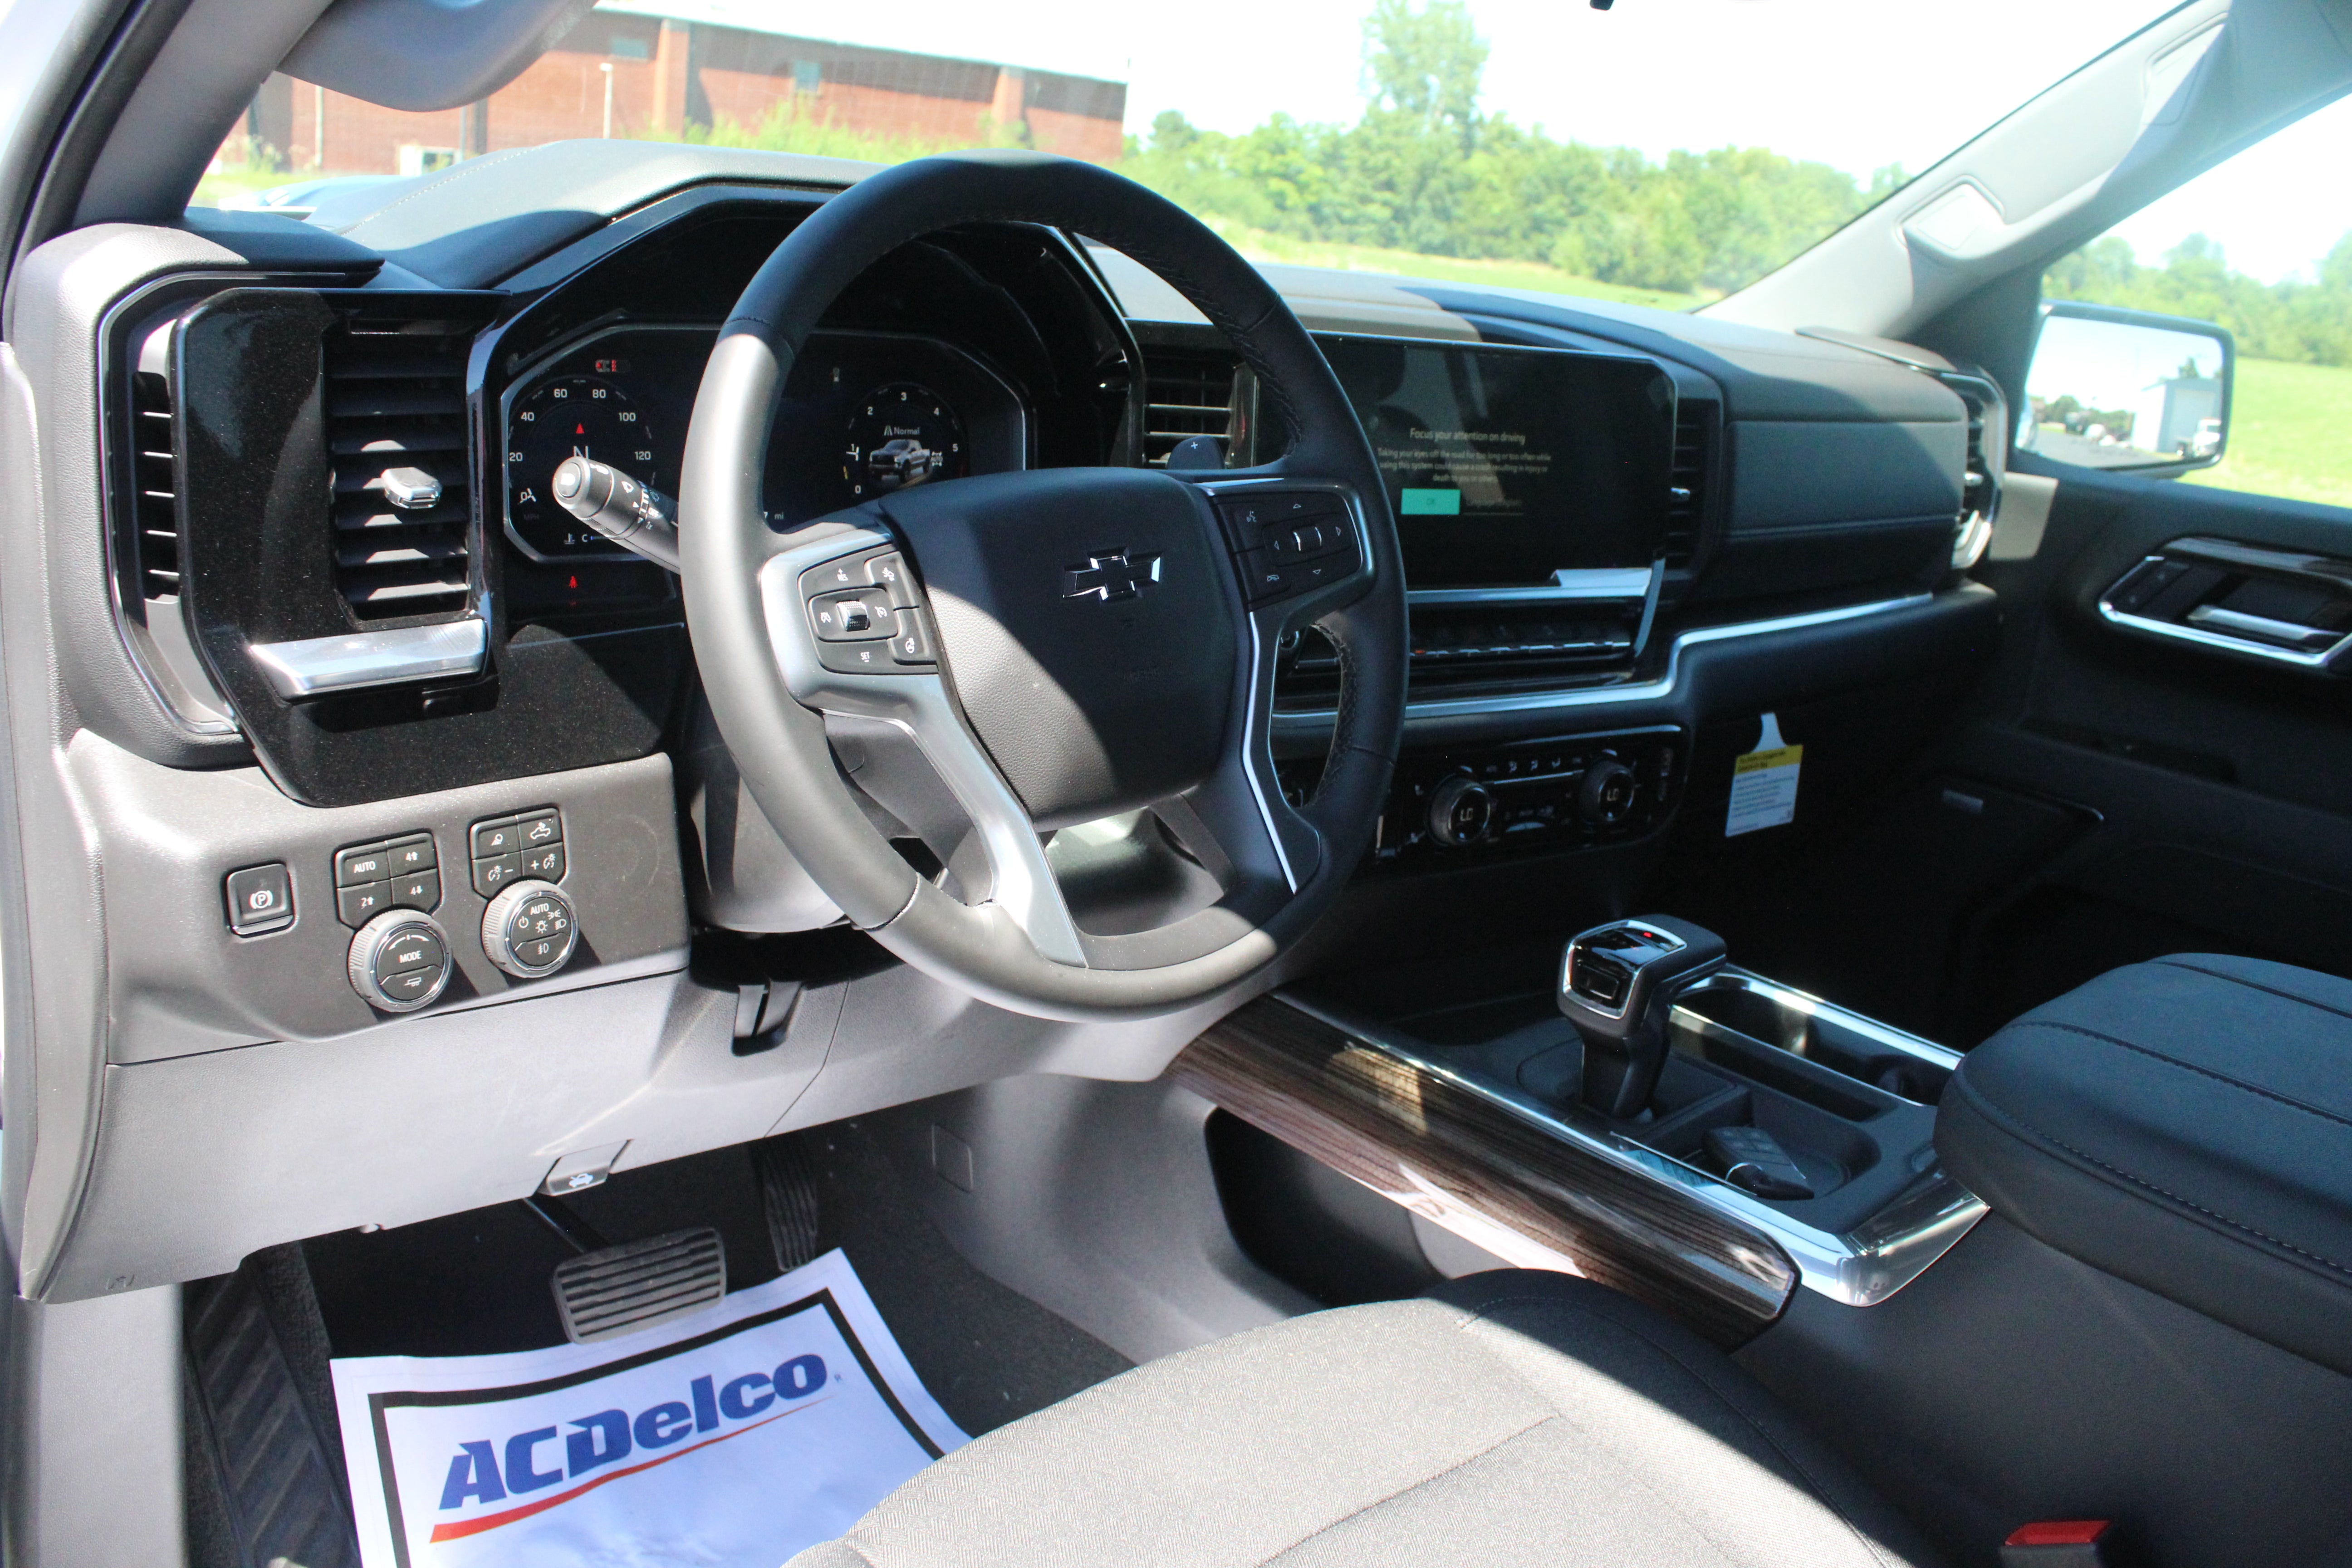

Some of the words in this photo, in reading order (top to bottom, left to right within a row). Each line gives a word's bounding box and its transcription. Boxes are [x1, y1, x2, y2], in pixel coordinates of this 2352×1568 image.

[554, 389, 567, 398] 60
[593, 389, 606, 398] 80
[901, 392, 907, 401] 3
[867, 407, 873, 415] 2
[934, 407, 939, 416] 4
[521, 412, 534, 421] 40
[618, 412, 636, 421] 100
[894, 426, 920, 435] Normal
[1410, 427, 1433, 439] Focus
[953, 444, 958, 452] 5
[509, 453, 523, 461] 20
[635, 451, 651, 460] 120
[855, 485, 861, 494] 0
[582, 534, 588, 542] C
[353, 861, 376, 873] AUTO
[530, 903, 549, 916] AUTO
[399, 951, 421, 963] MODE
[439, 1353, 828, 1510] ACDelco
